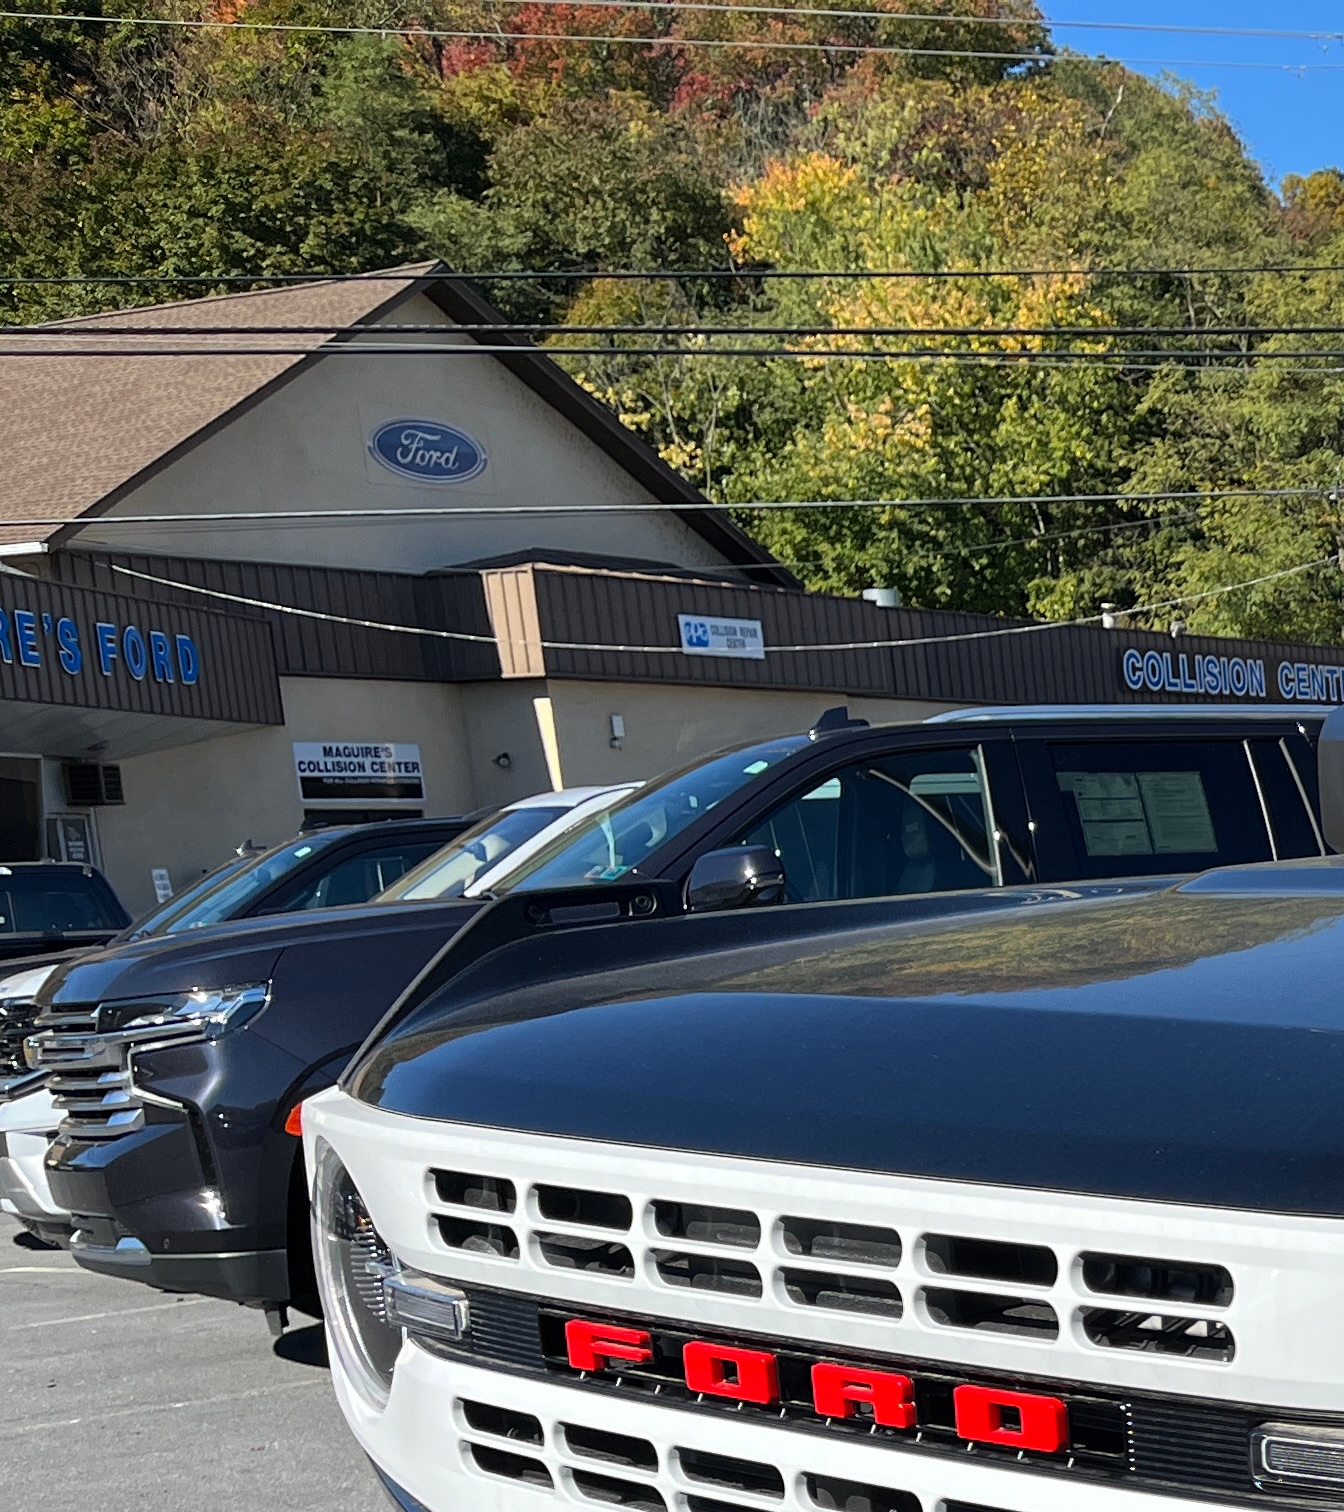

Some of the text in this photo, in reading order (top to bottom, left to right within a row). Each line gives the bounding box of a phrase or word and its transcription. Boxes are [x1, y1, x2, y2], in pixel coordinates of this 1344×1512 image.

[396, 429, 459, 469] Ford
[96, 622, 200, 686] FORD
[1122, 648, 1267, 697] COLLISION
[297, 760, 420, 773] COLLISION CENTER
[322, 745, 393, 758] MAGUIRE'S
[564, 1319, 1070, 1454] FORD
